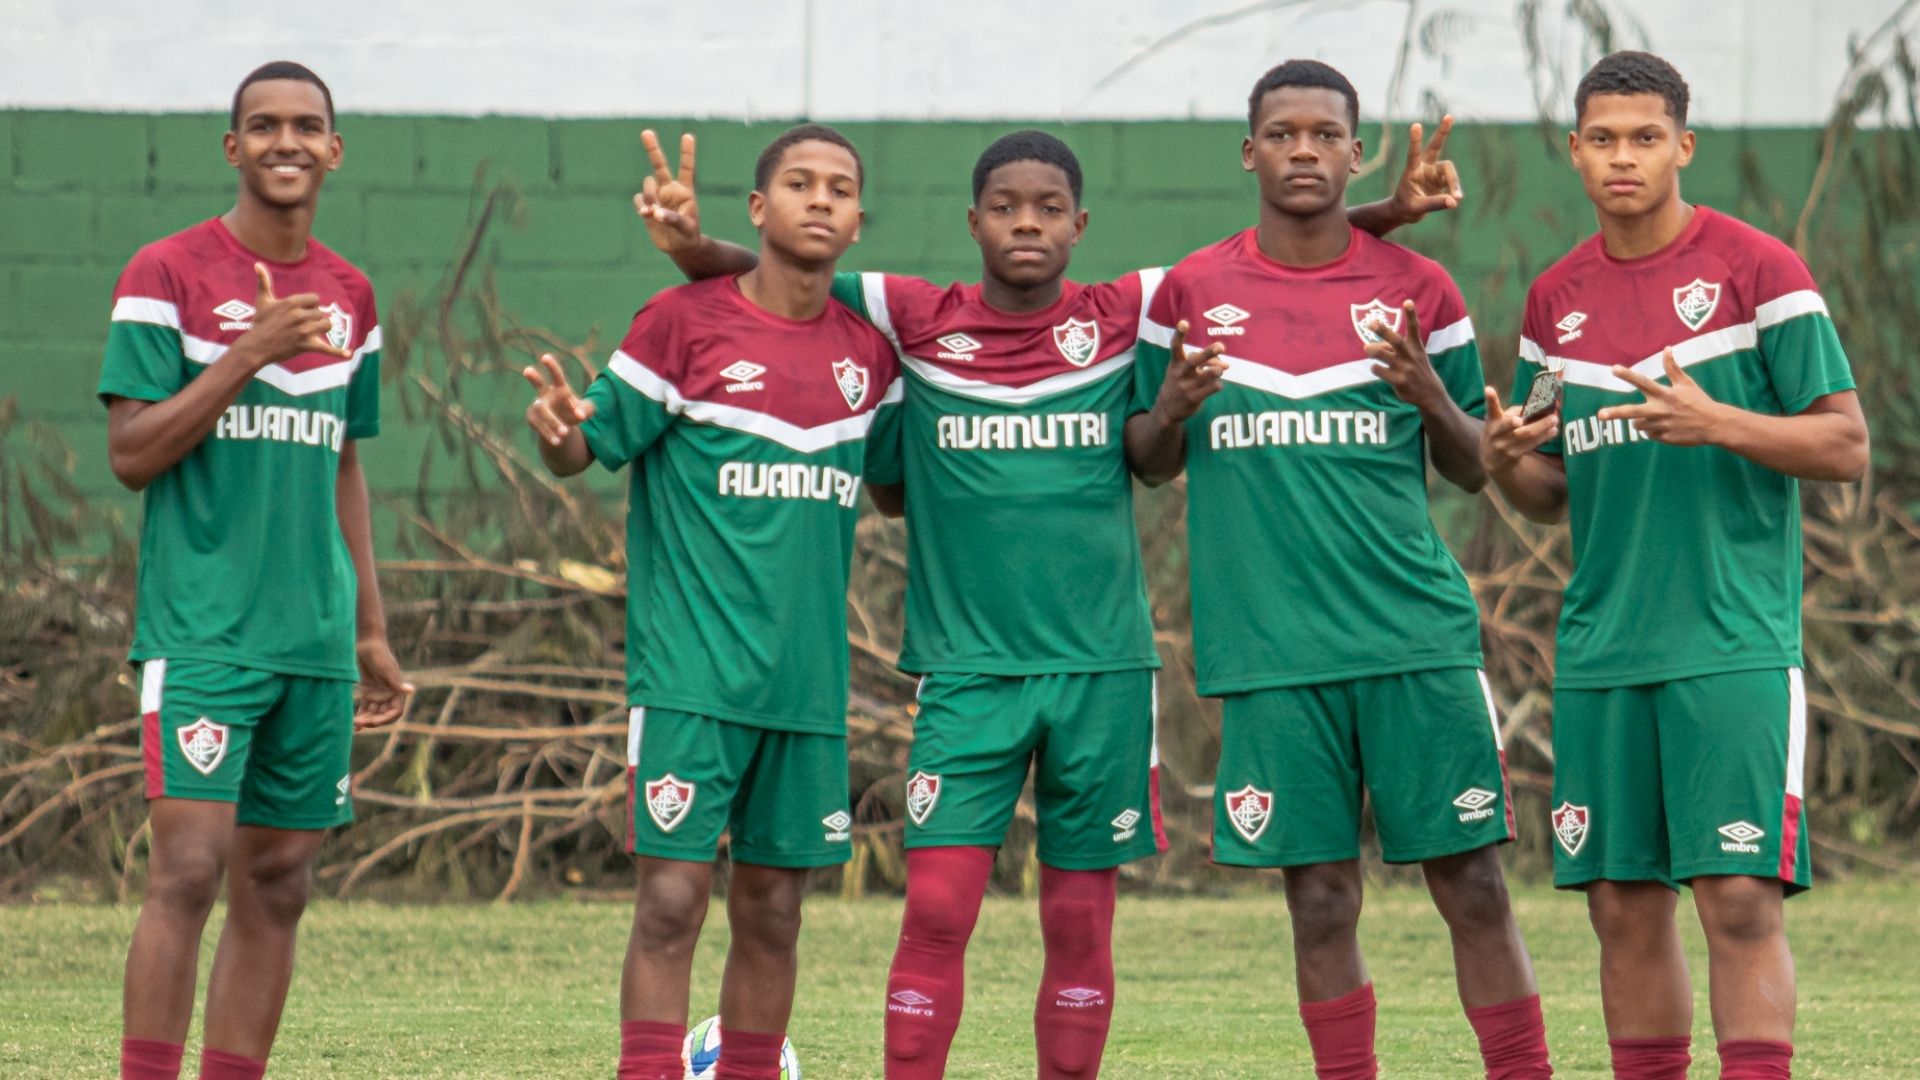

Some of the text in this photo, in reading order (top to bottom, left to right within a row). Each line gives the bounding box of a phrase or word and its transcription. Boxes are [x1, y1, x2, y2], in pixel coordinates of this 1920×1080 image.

[1207, 324, 1245, 336] umbro
[937, 351, 975, 362] umbro
[726, 381, 765, 394] umbro
[1459, 807, 1494, 823] umbro
[1720, 840, 1760, 853] umbro
[1056, 998, 1105, 1008] umbro
[888, 1003, 935, 1017] umbro
